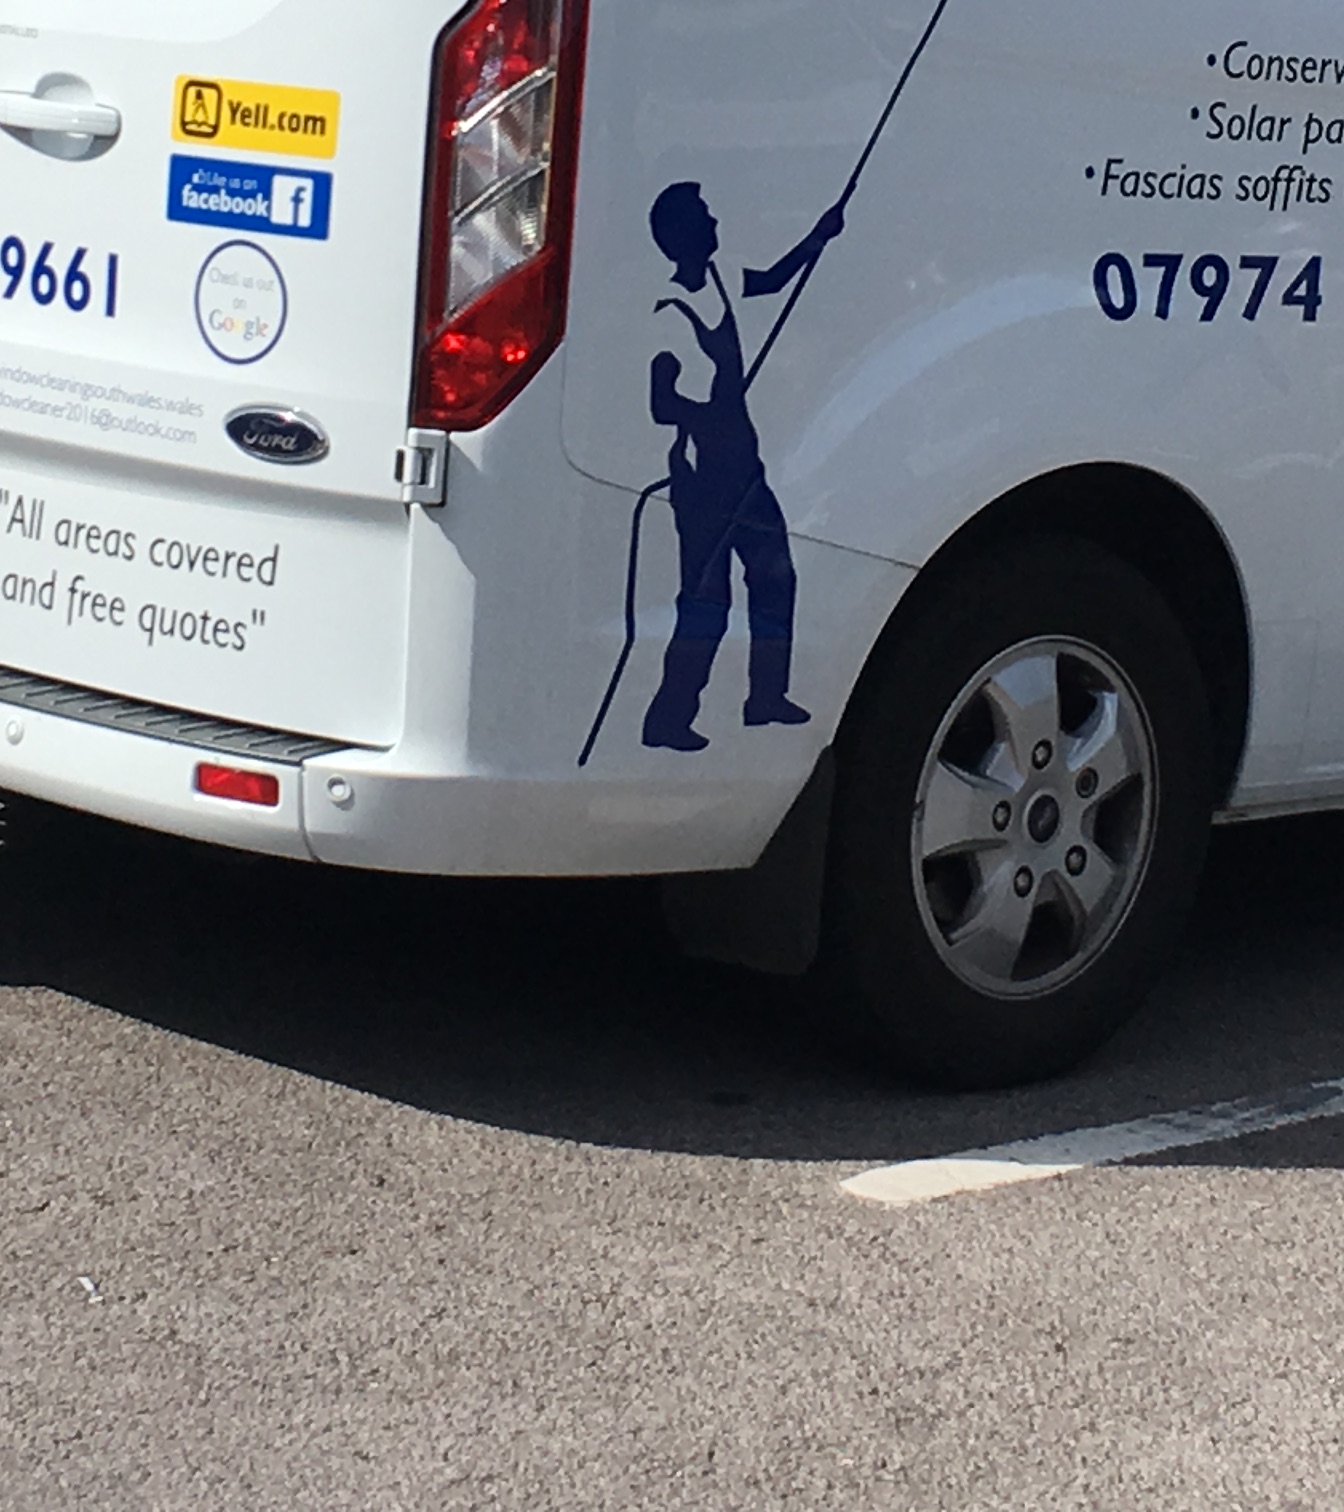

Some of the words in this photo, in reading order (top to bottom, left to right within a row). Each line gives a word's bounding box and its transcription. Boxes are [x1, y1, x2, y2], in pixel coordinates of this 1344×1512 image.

[228, 99, 328, 136] Yell.com
[1206, 102, 1292, 143] Solar
[181, 183, 269, 218] facebook
[1100, 158, 1223, 203] Fascias
[1235, 164, 1332, 212] soffits
[1092, 251, 1323, 324] 07974
[209, 308, 269, 341] Google
[243, 418, 299, 451] Ford
[54, 517, 137, 562] areas
[148, 543, 280, 587] covered
[1, 569, 57, 611] and
[67, 574, 126, 626] free
[138, 608, 266, 652] quotes"
